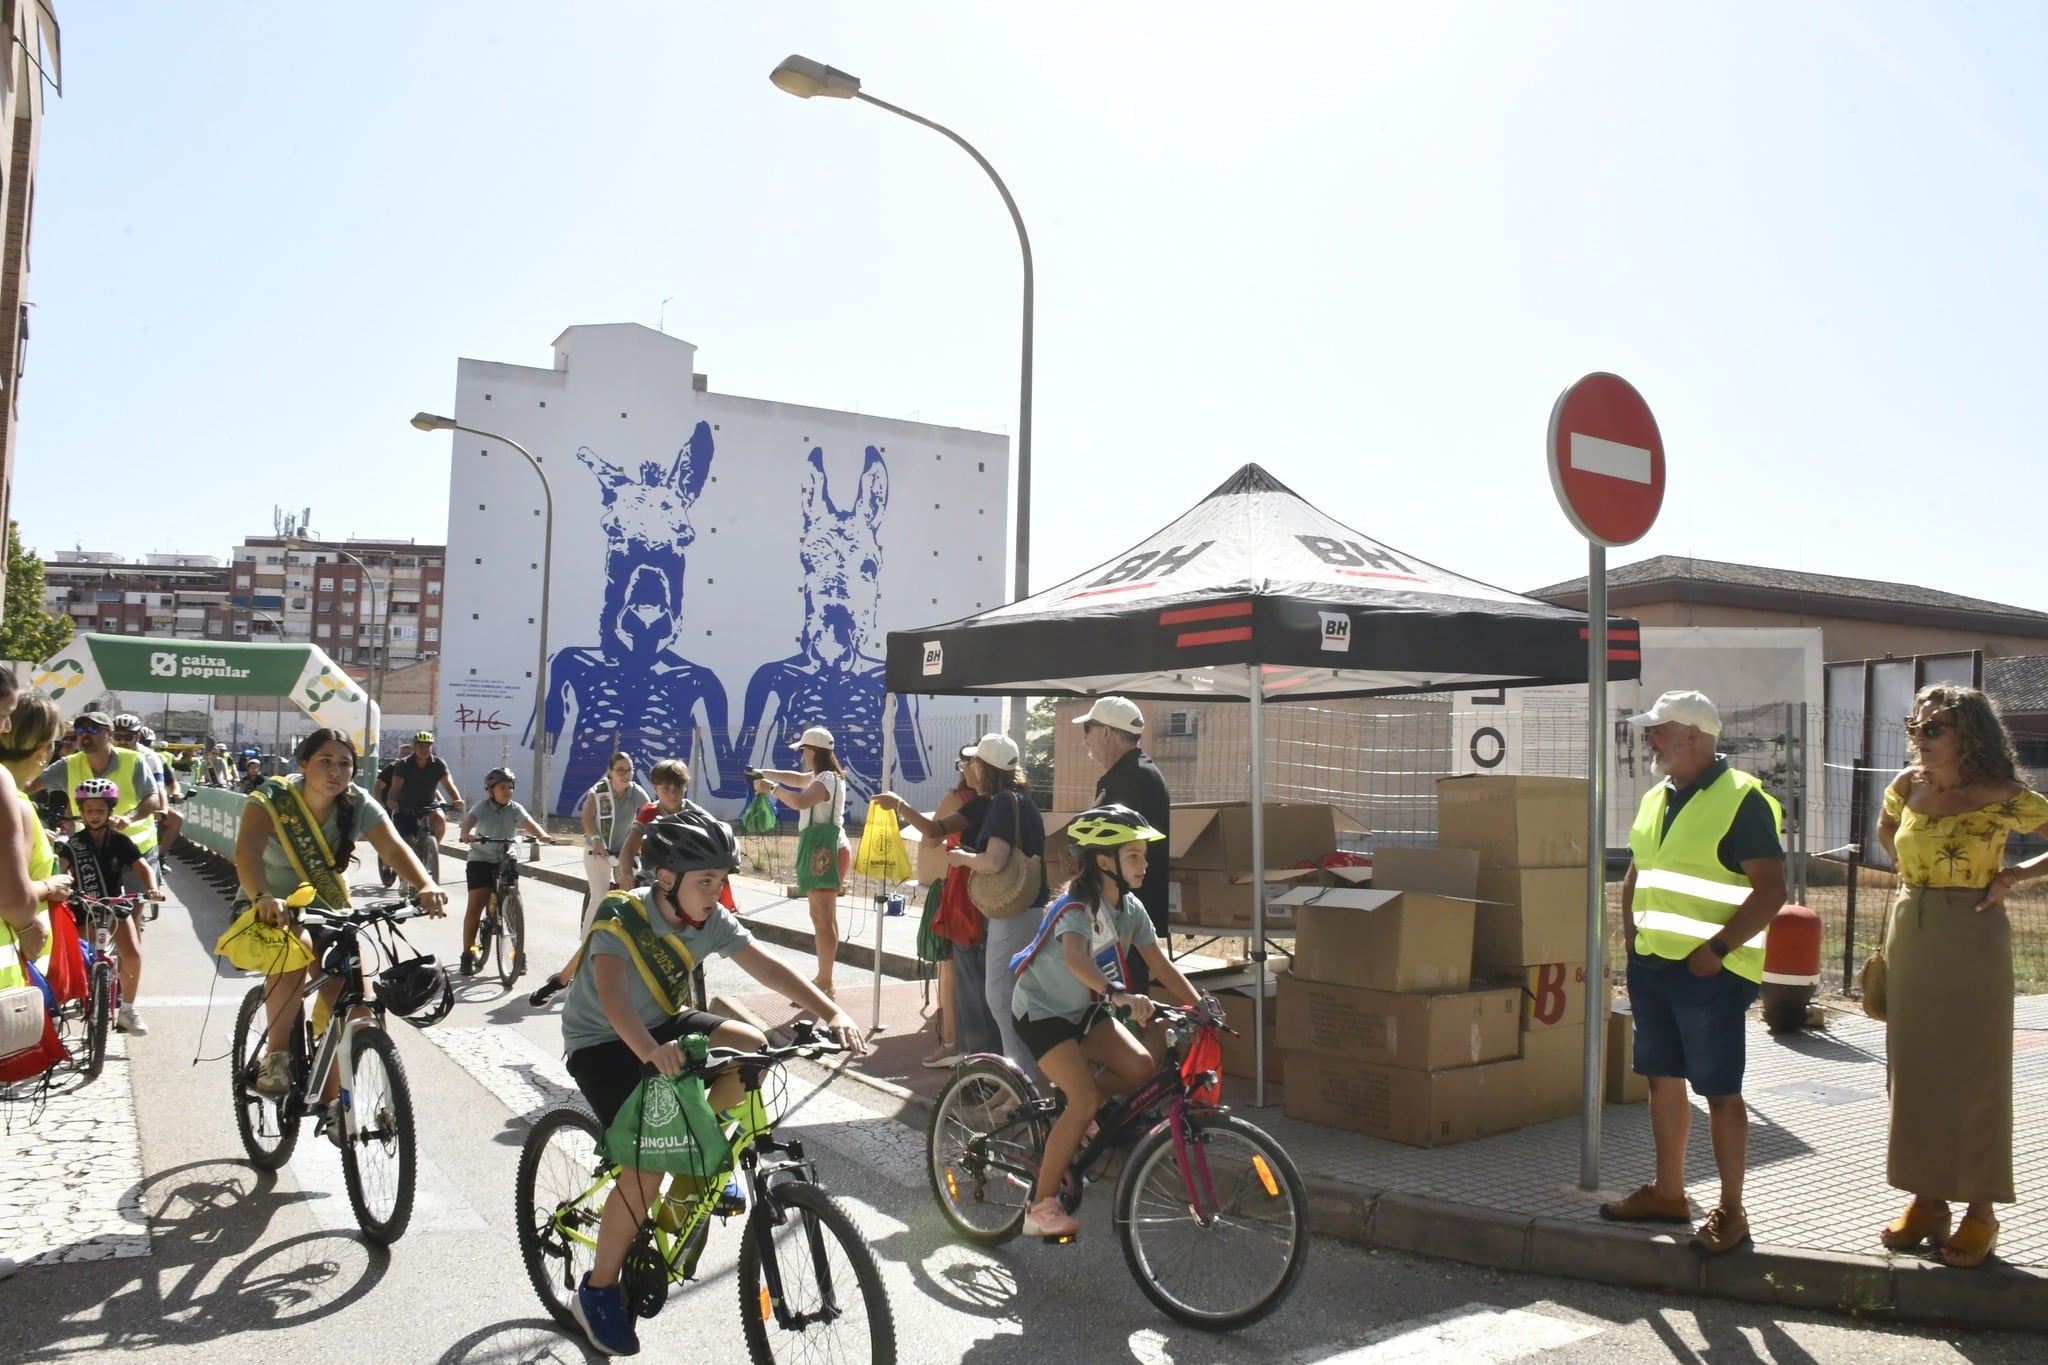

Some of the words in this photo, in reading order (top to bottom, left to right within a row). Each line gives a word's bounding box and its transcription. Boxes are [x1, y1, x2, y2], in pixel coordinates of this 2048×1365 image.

[1295, 535, 1416, 575] BH
[1086, 540, 1216, 588] BH
[1325, 620, 1348, 636] BH
[181, 655, 226, 667] caixa
[926, 649, 941, 663] BH
[181, 666, 251, 678] popular
[653, 950, 676, 978] 2025
[1533, 963, 1566, 1026] B
[640, 1134, 695, 1149] SINGULA
